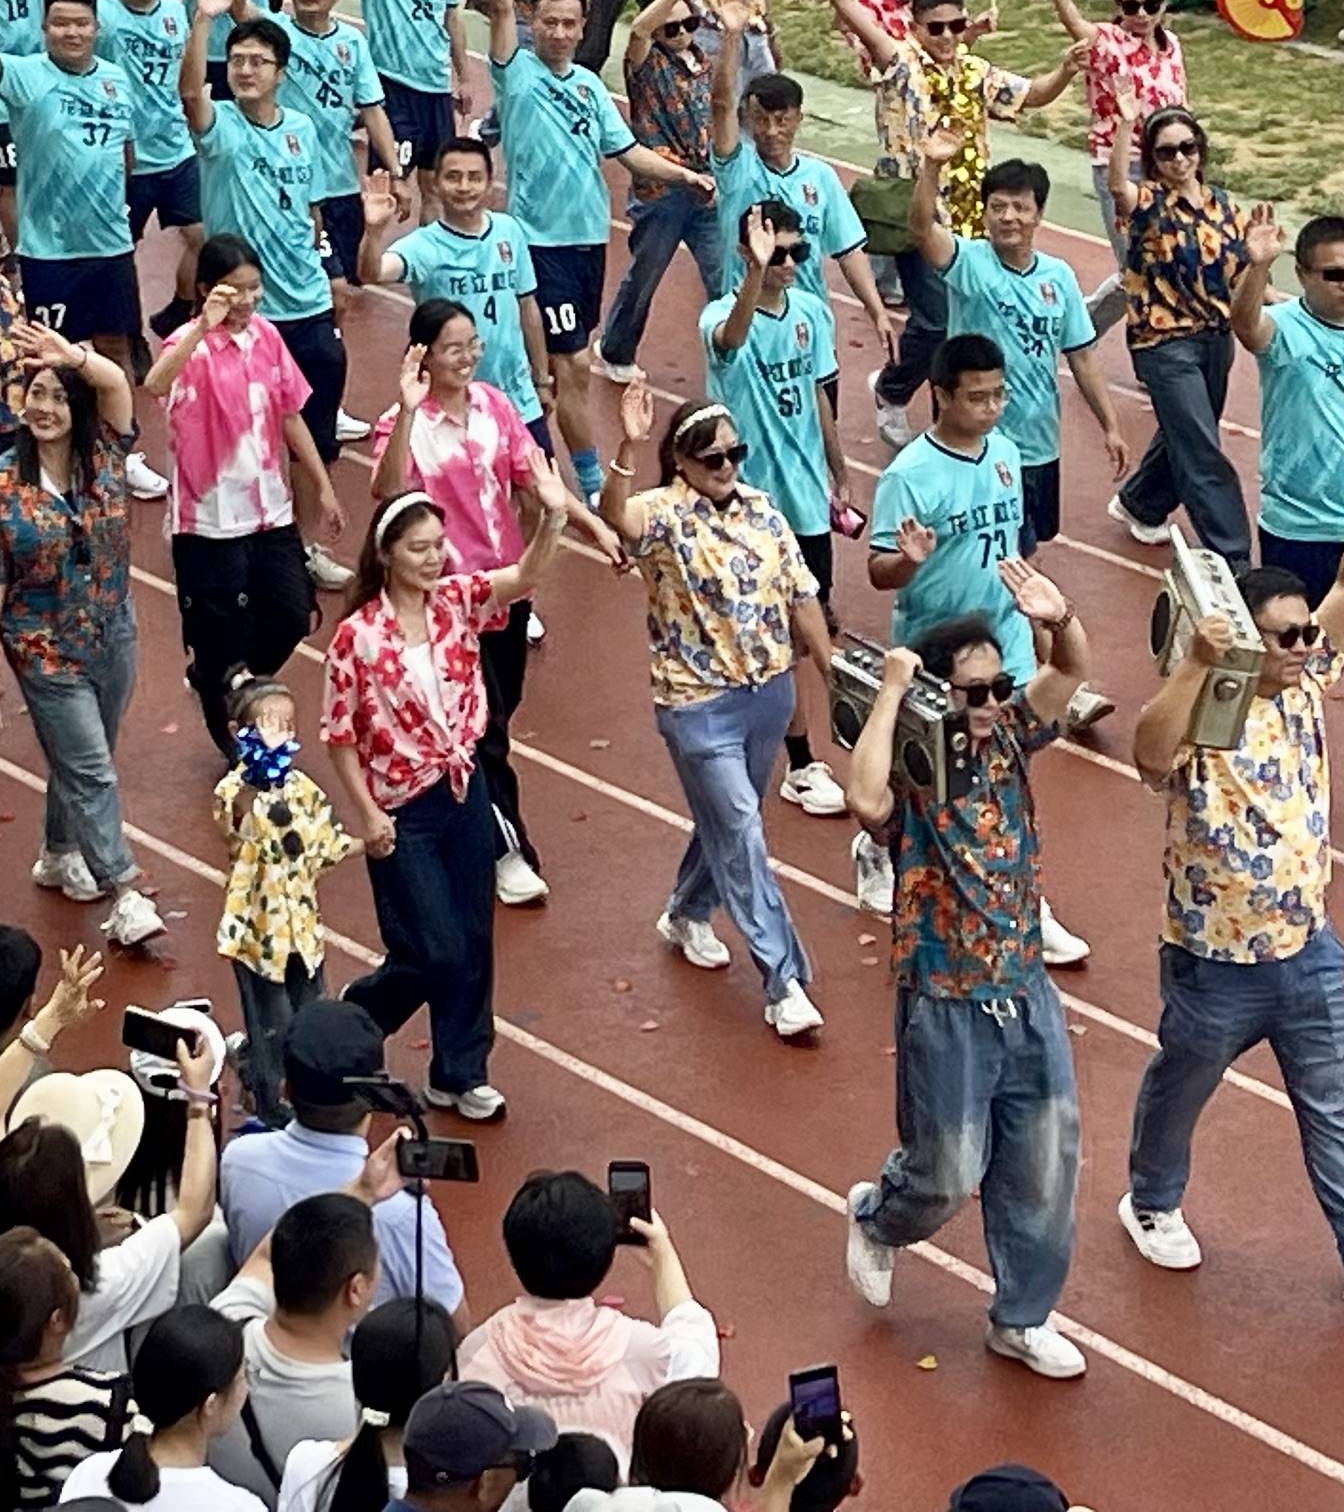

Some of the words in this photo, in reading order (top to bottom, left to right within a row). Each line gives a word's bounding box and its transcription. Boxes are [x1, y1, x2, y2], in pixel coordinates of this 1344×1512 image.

[82, 121, 113, 147] 37
[483, 295, 498, 326] 4
[544, 302, 577, 336] 10
